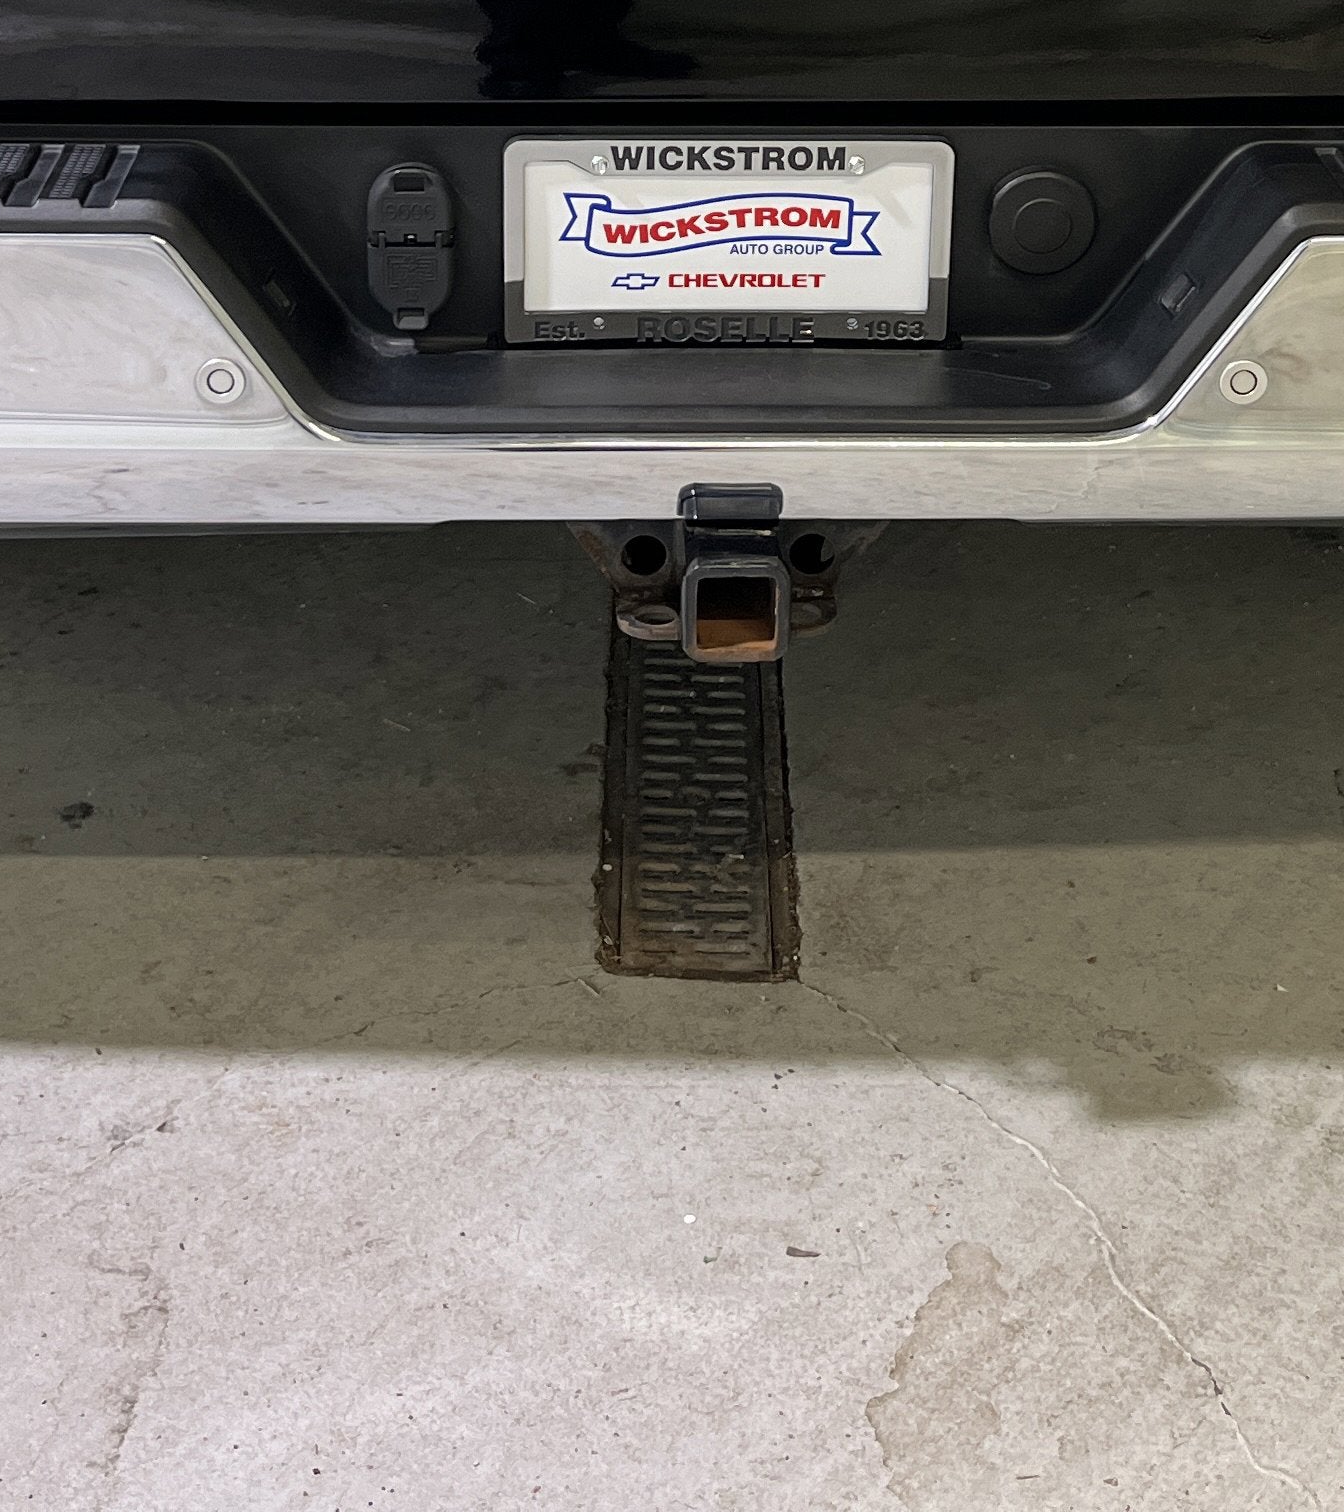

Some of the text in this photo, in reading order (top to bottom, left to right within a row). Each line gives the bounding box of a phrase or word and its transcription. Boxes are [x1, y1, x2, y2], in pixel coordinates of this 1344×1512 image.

[610, 145, 847, 171] WICKSTROM
[602, 206, 842, 245] WICKSTROM
[729, 244, 825, 256] AUTO GROUP
[668, 273, 826, 288] CHEVROLET
[533, 315, 926, 343] Est. ROSELLE 1963
